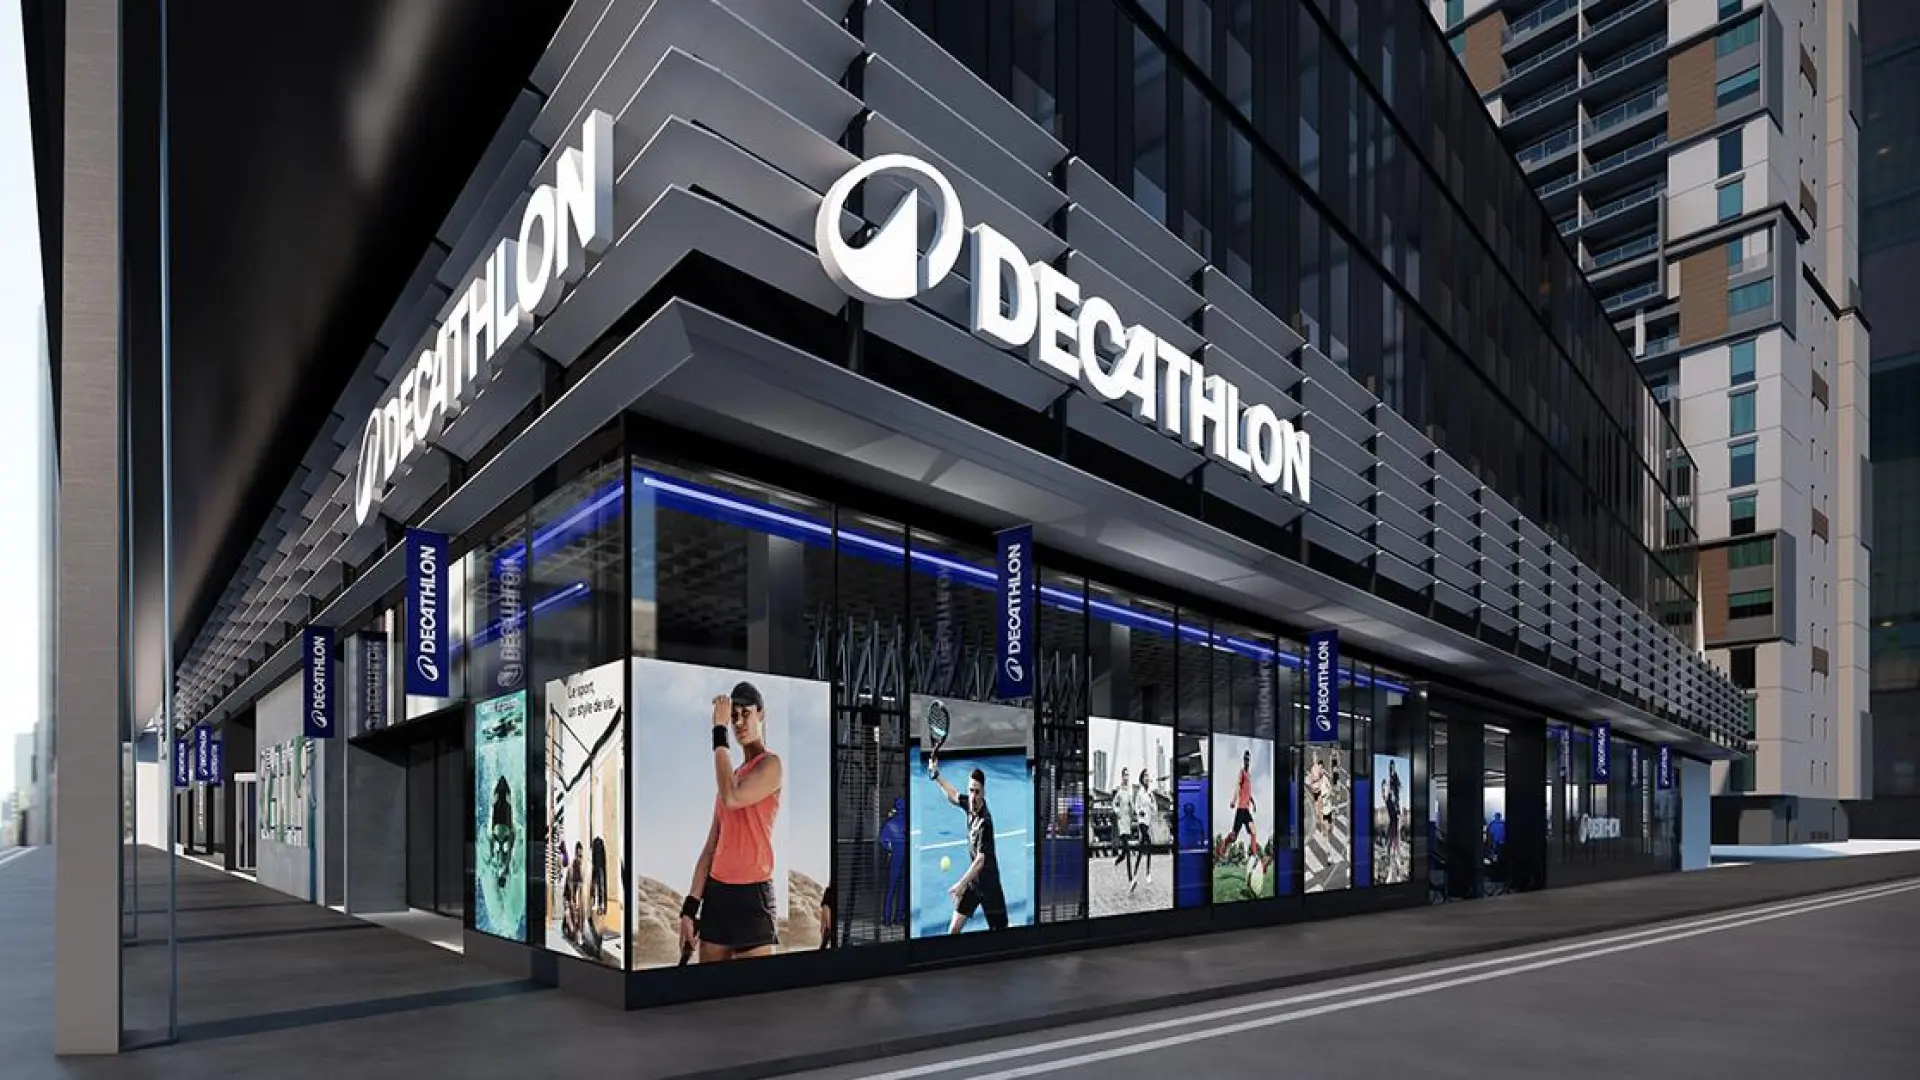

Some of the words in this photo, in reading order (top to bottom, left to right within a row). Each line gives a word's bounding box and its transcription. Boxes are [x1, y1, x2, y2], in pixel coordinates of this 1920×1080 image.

[382, 108, 613, 481] DECATHLON
[971, 222, 1310, 504] DECATHLON
[419, 546, 436, 653] DECATHLON
[1007, 543, 1021, 655] DECATHLON
[312, 636, 325, 710] DECATHLON
[1317, 640, 1329, 713] DECATHLON
